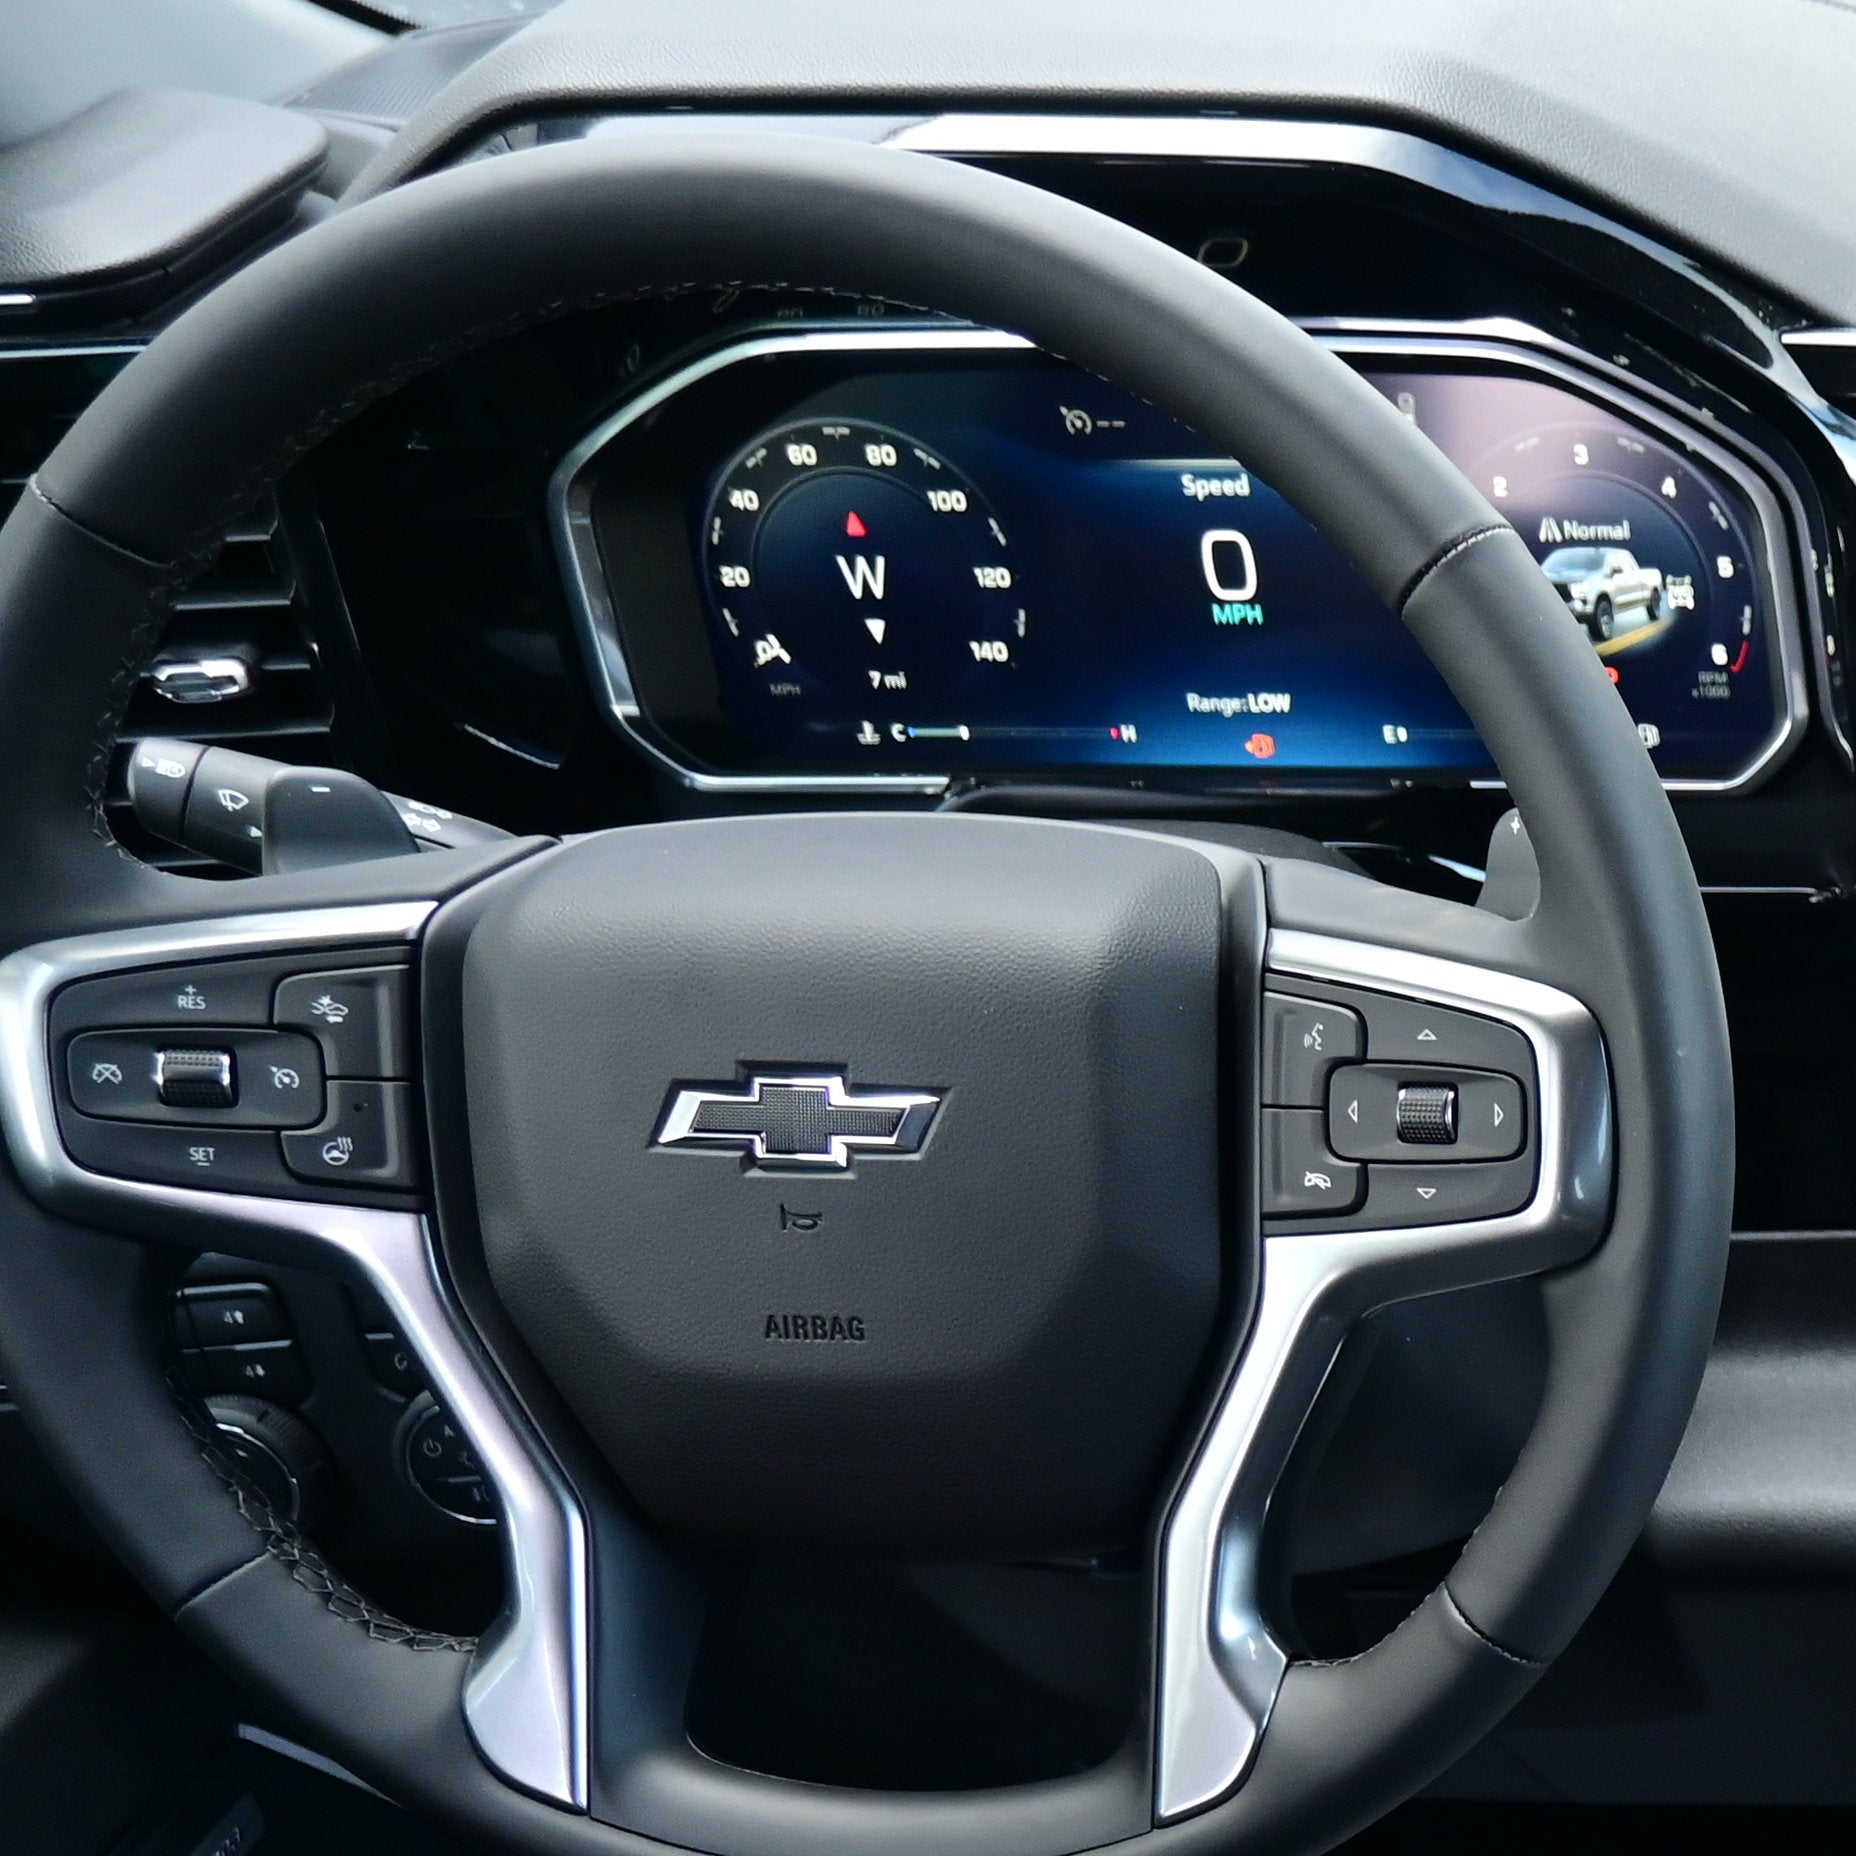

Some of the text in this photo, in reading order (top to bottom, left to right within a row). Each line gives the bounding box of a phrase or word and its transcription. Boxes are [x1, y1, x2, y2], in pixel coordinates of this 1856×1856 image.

[787, 443, 818, 467] 60
[865, 443, 898, 467] 80
[1573, 444, 1590, 466] 3
[1180, 473, 1251, 502] Speed
[1492, 476, 1508, 498] 2
[1661, 476, 1678, 498] 4
[729, 489, 760, 512] 40
[927, 489, 968, 513] 100
[1563, 519, 1631, 542] Normal
[720, 565, 751, 588] 20
[1201, 529, 1258, 601] 0
[1716, 555, 1735, 580] 5
[835, 555, 886, 600] W
[973, 566, 1012, 589] 120
[1211, 603, 1264, 626] MPH
[969, 640, 1009, 663] 140
[1247, 692, 1292, 714] LOW
[177, 995, 206, 1010] RES
[189, 1147, 216, 1162] SET
[764, 1314, 866, 1343] AIRBAG
